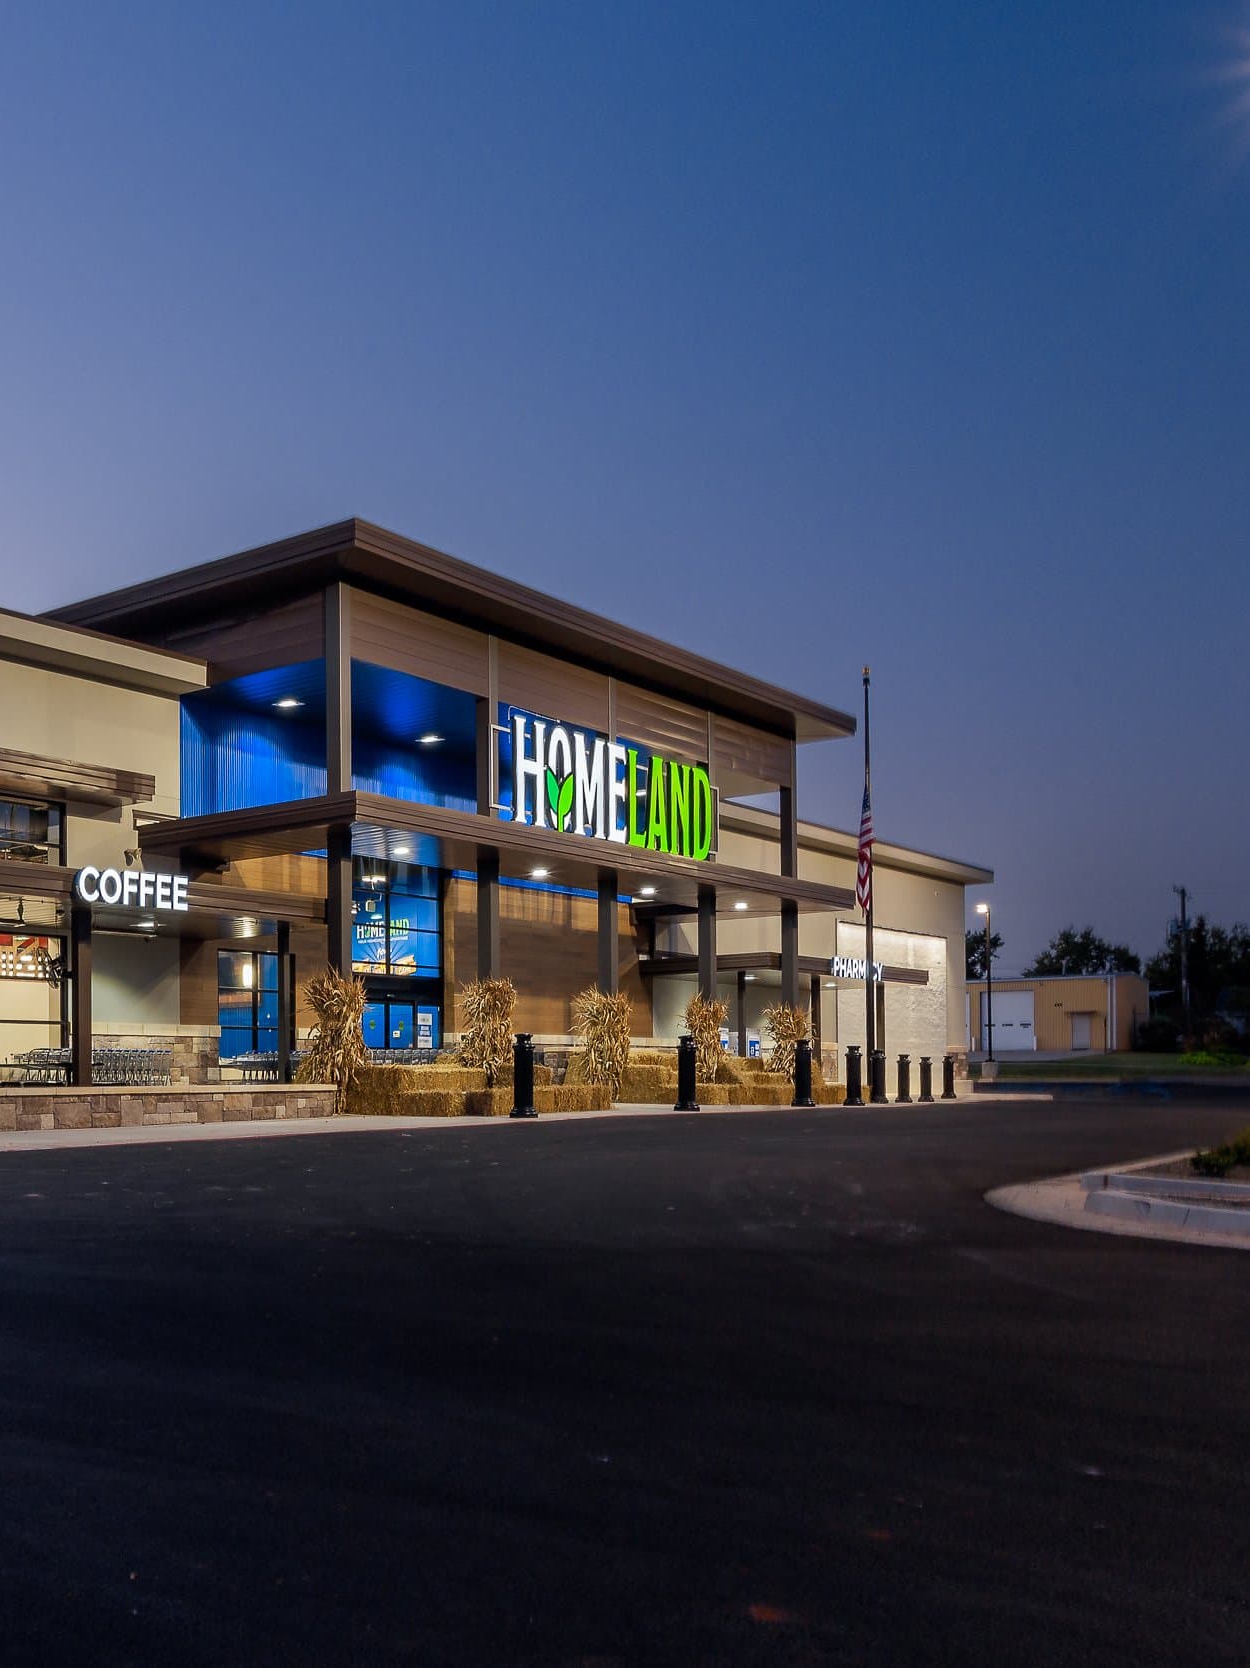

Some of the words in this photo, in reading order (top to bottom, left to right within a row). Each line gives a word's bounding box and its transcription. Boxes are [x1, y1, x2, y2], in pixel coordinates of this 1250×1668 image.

[513, 715, 712, 861] HOMELAND
[78, 865, 189, 912] COFFEE
[356, 918, 410, 939] HOMEAND
[833, 956, 883, 982] PHARMY
